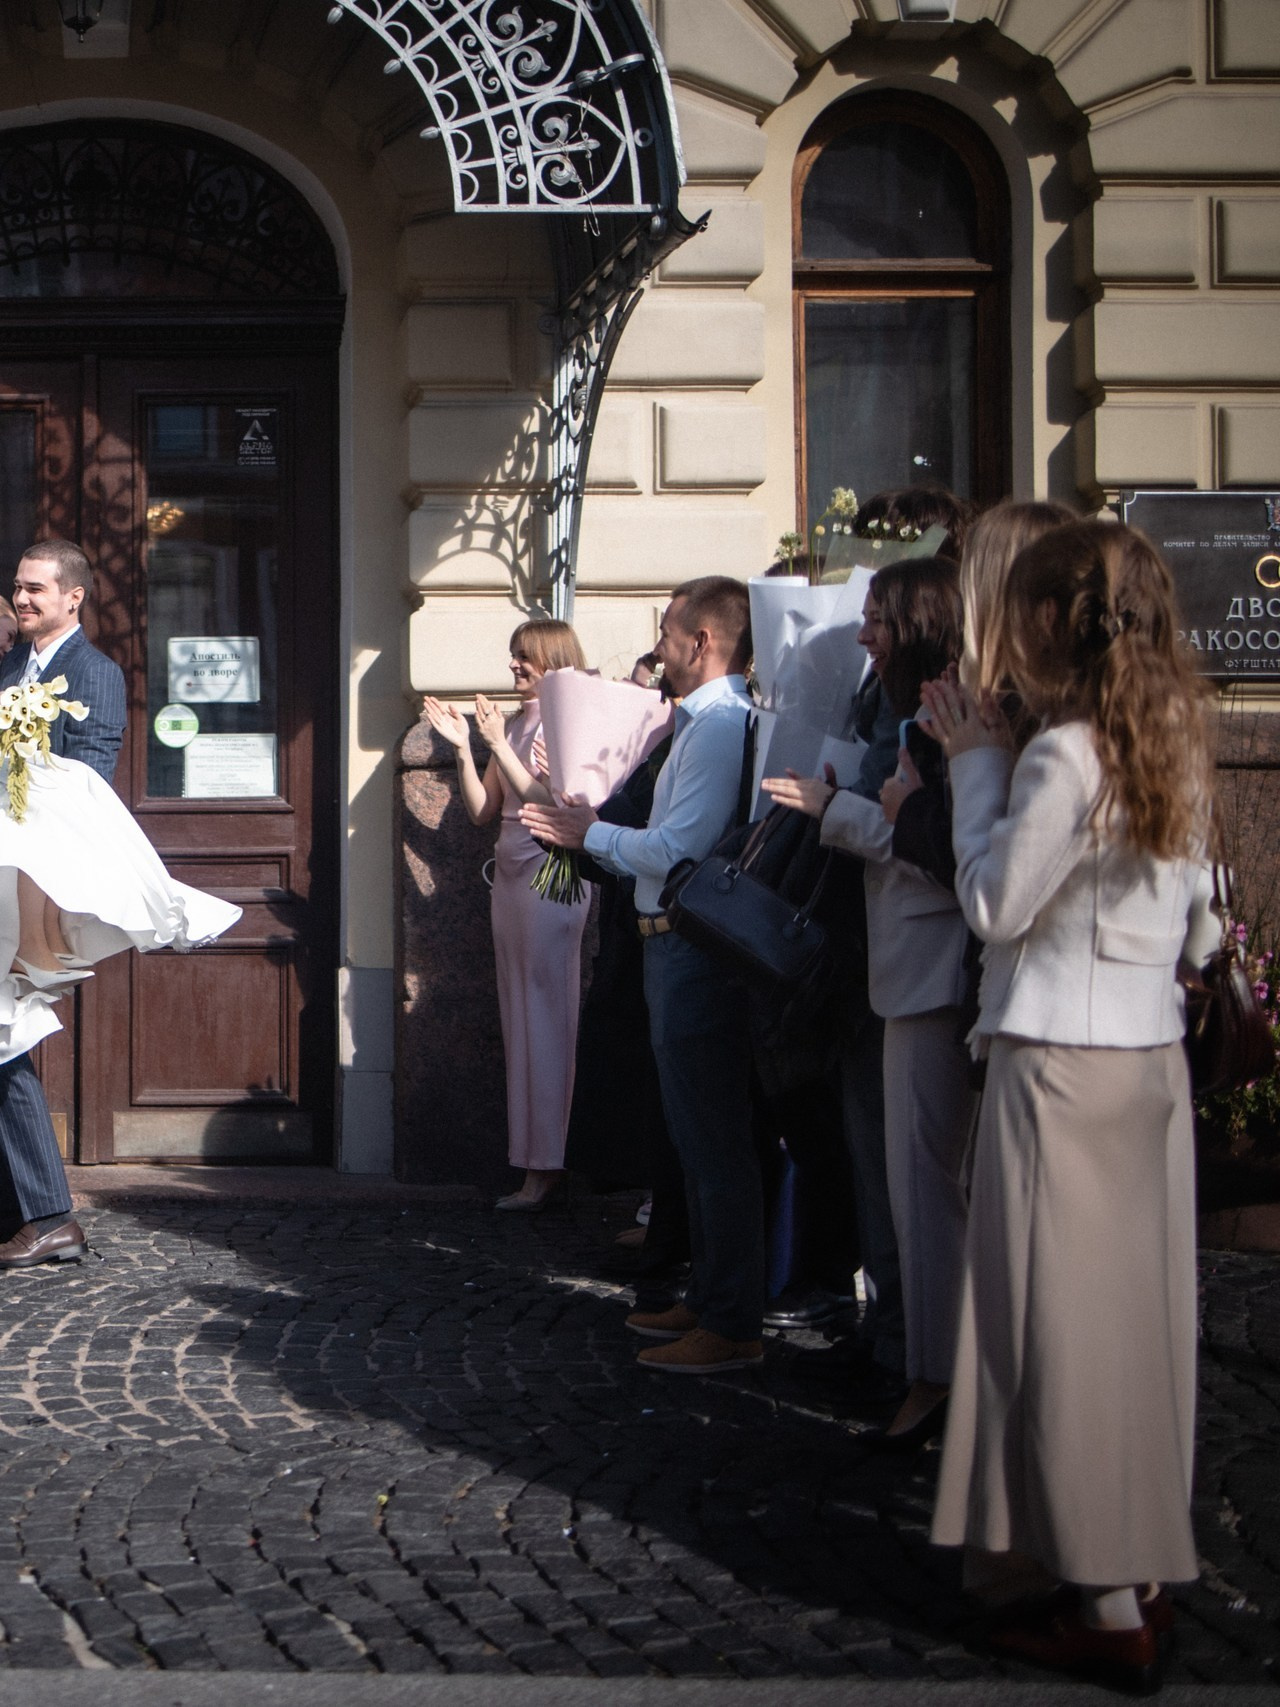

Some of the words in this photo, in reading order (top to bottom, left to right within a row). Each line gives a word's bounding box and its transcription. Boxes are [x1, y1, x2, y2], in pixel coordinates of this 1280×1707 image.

[190, 652, 241, 661] Апостиль
[193, 669, 205, 677] во
[208, 669, 239, 678] дворе
